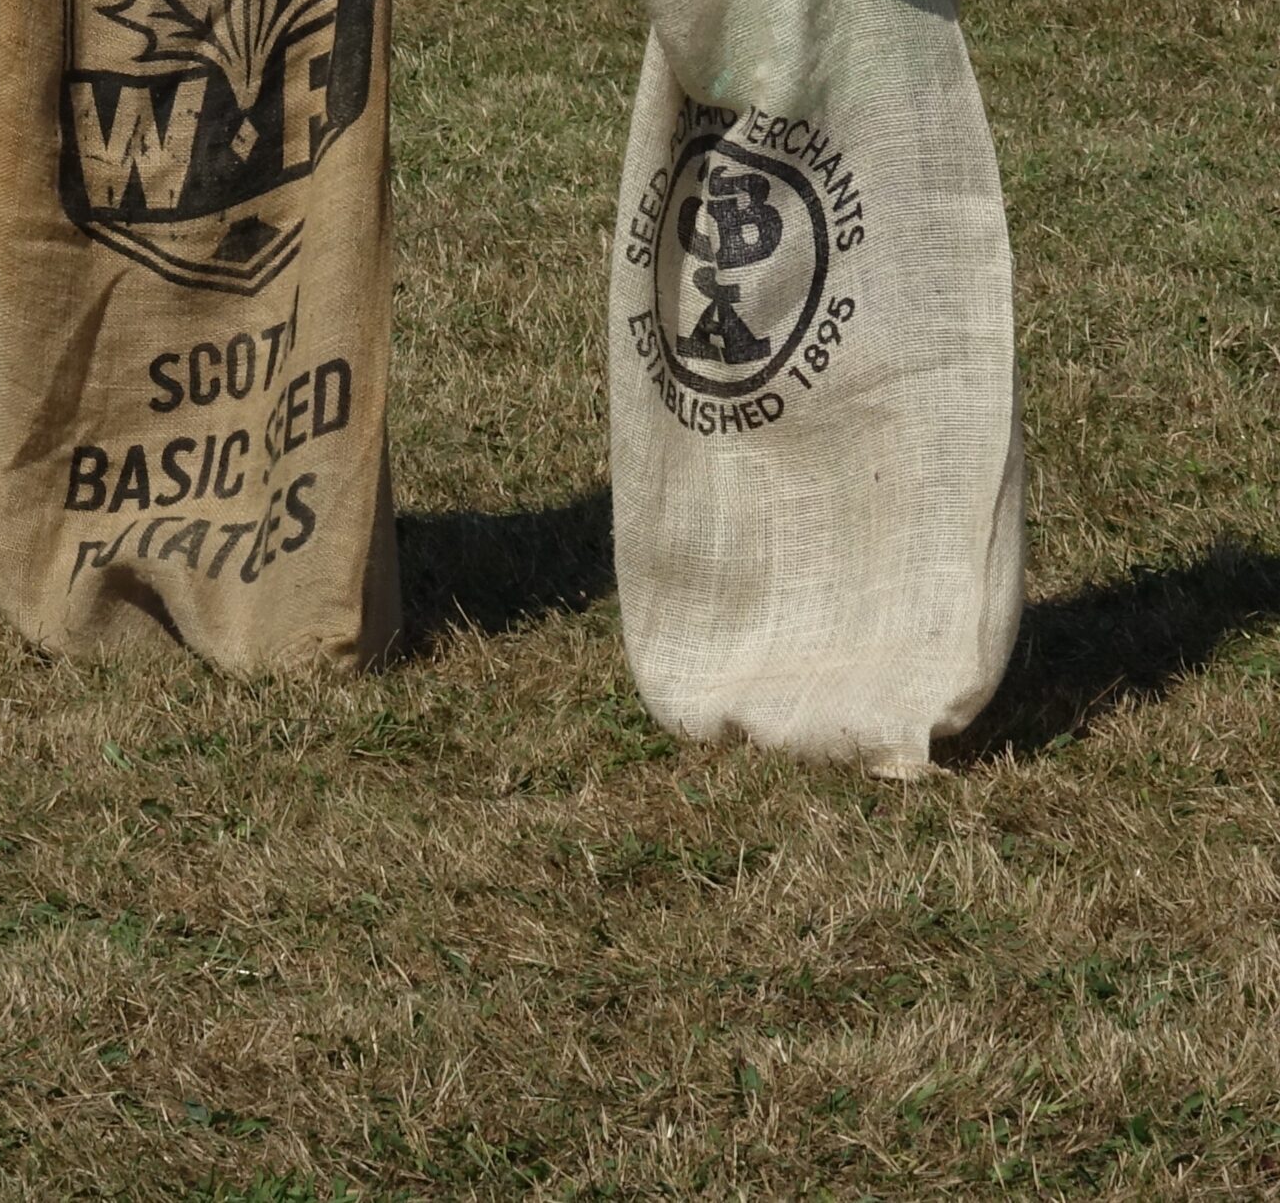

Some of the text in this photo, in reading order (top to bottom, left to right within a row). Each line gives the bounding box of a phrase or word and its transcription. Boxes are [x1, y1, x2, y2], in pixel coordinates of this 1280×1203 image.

[627, 310, 785, 437] ESTABLISHED
[788, 296, 856, 390] 1895
[63, 427, 250, 514] BASIC
